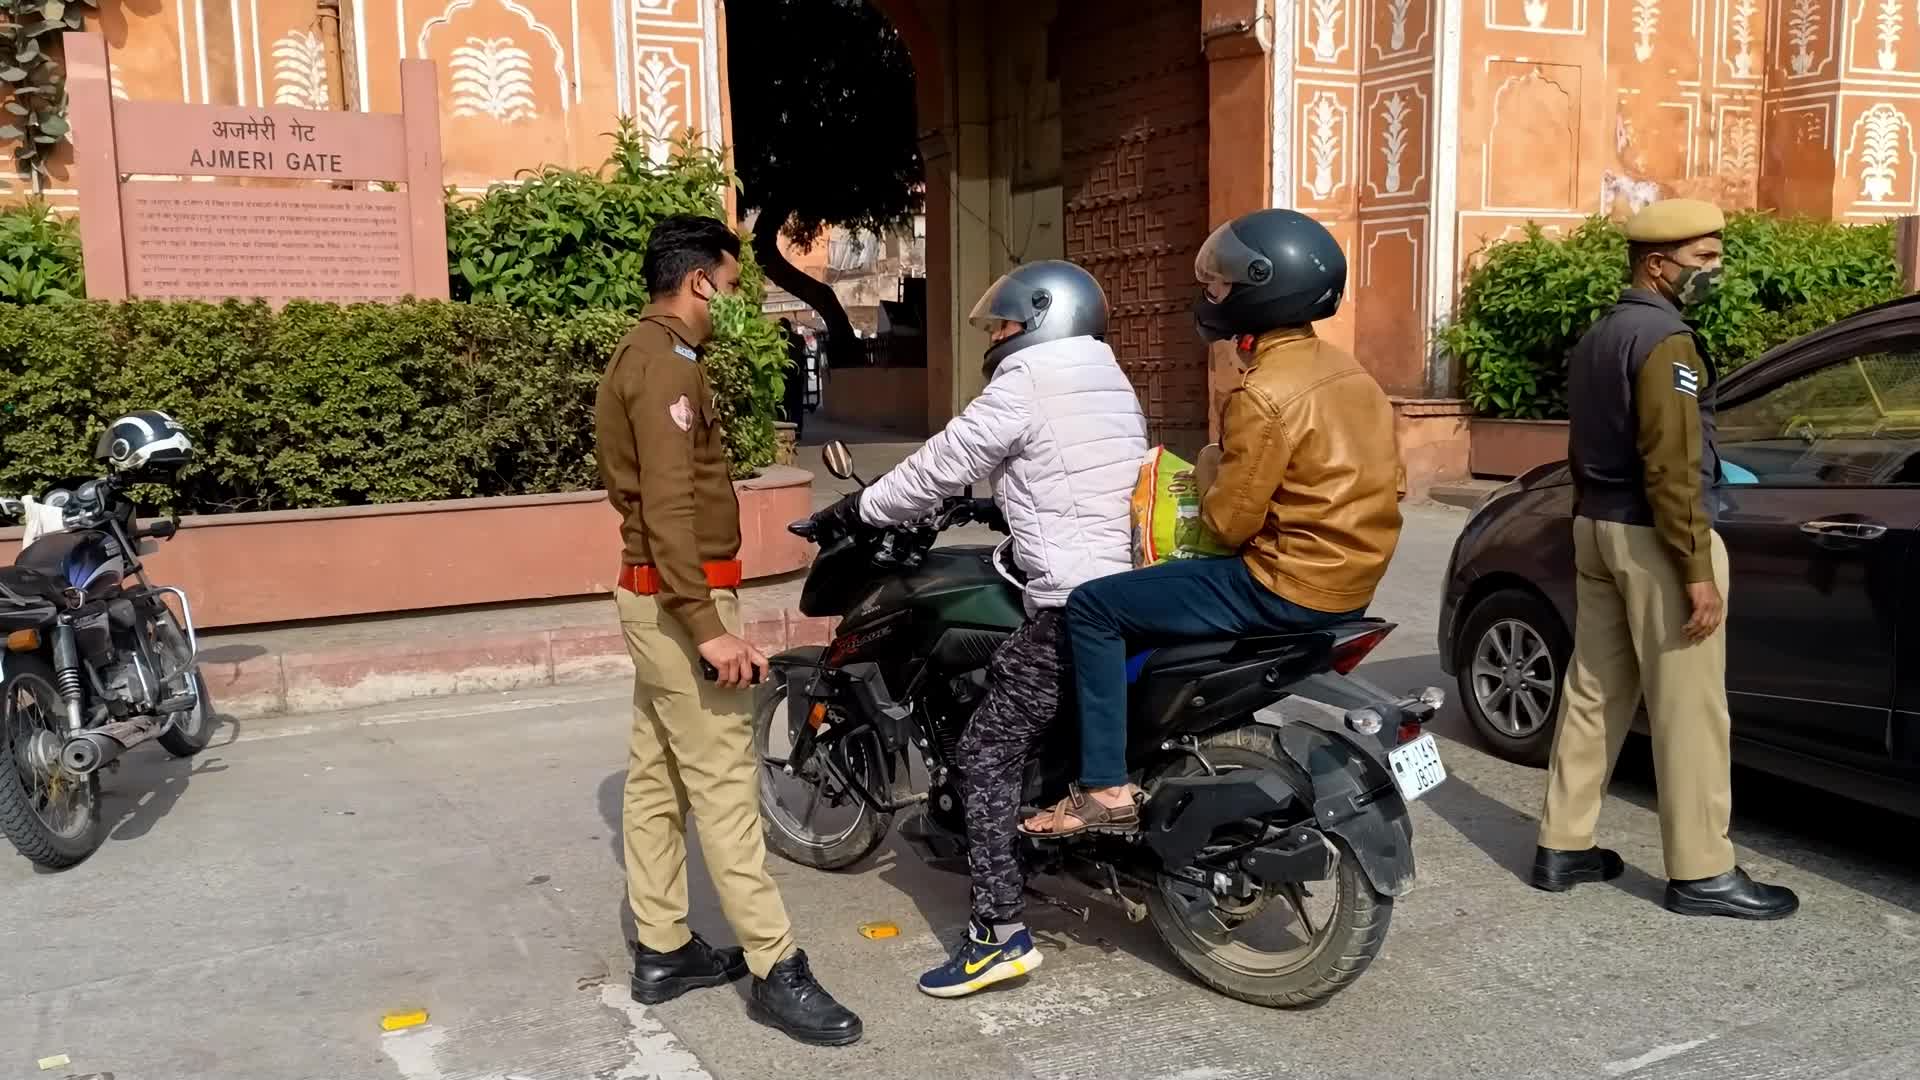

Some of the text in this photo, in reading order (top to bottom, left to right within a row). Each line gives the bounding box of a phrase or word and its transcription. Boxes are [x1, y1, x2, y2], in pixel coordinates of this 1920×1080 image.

[212, 116, 316, 143] अजमेरी गेट
[190, 148, 343, 173] AJMERI GATE
